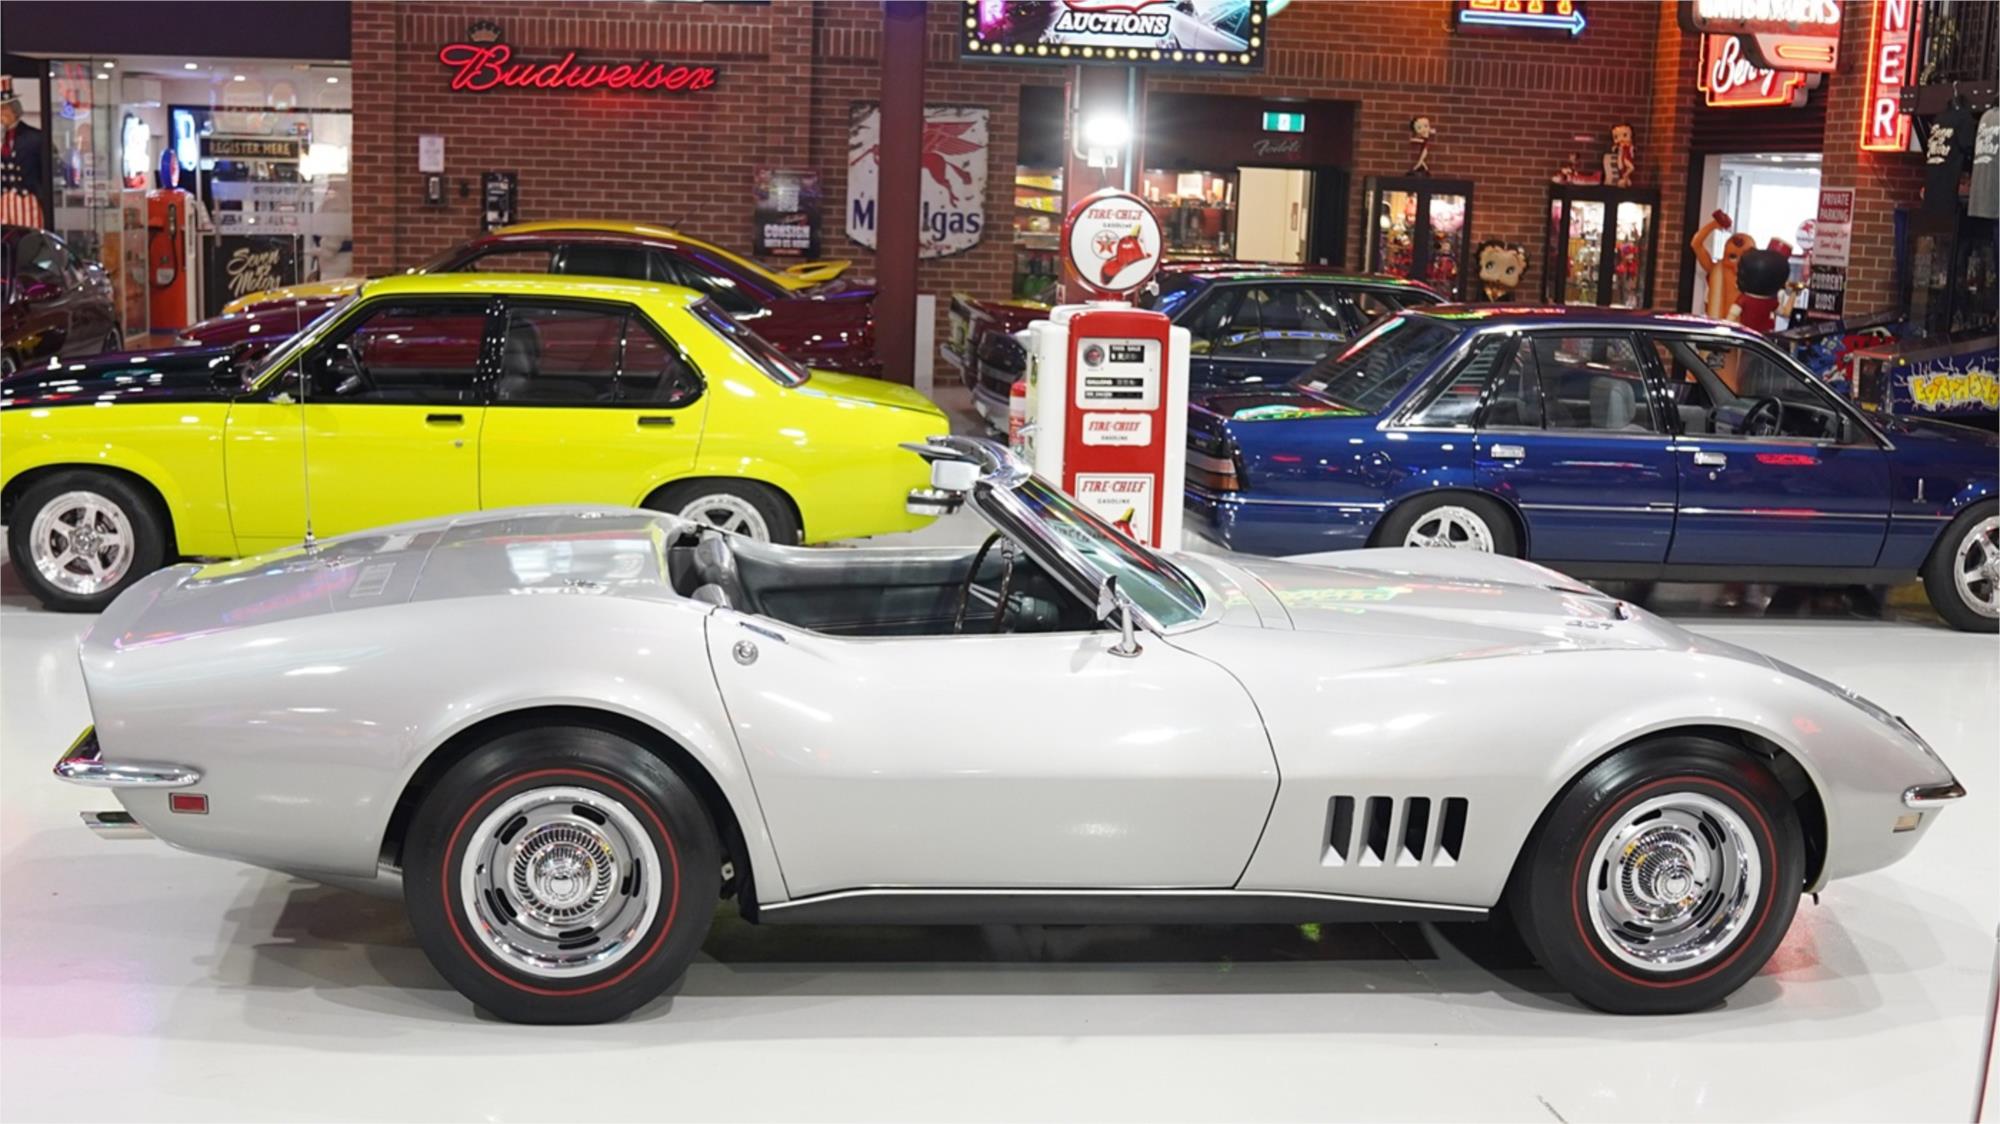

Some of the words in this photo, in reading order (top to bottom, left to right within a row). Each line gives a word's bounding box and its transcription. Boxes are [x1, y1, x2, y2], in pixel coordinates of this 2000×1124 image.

[1056, 12, 1169, 34] AUCTIONS
[439, 44, 715, 91] Budweiser
[209, 140, 260, 155] REGISTER
[263, 142, 291, 156] HERE
[1822, 192, 1849, 206] PRIVATE
[853, 199, 981, 241] Mlgas
[226, 247, 280, 275] Seven
[228, 271, 281, 297] Motors
[1088, 421, 1141, 432] FIRE-CHIEF
[1081, 481, 1147, 493] FIRE-CHIEF
